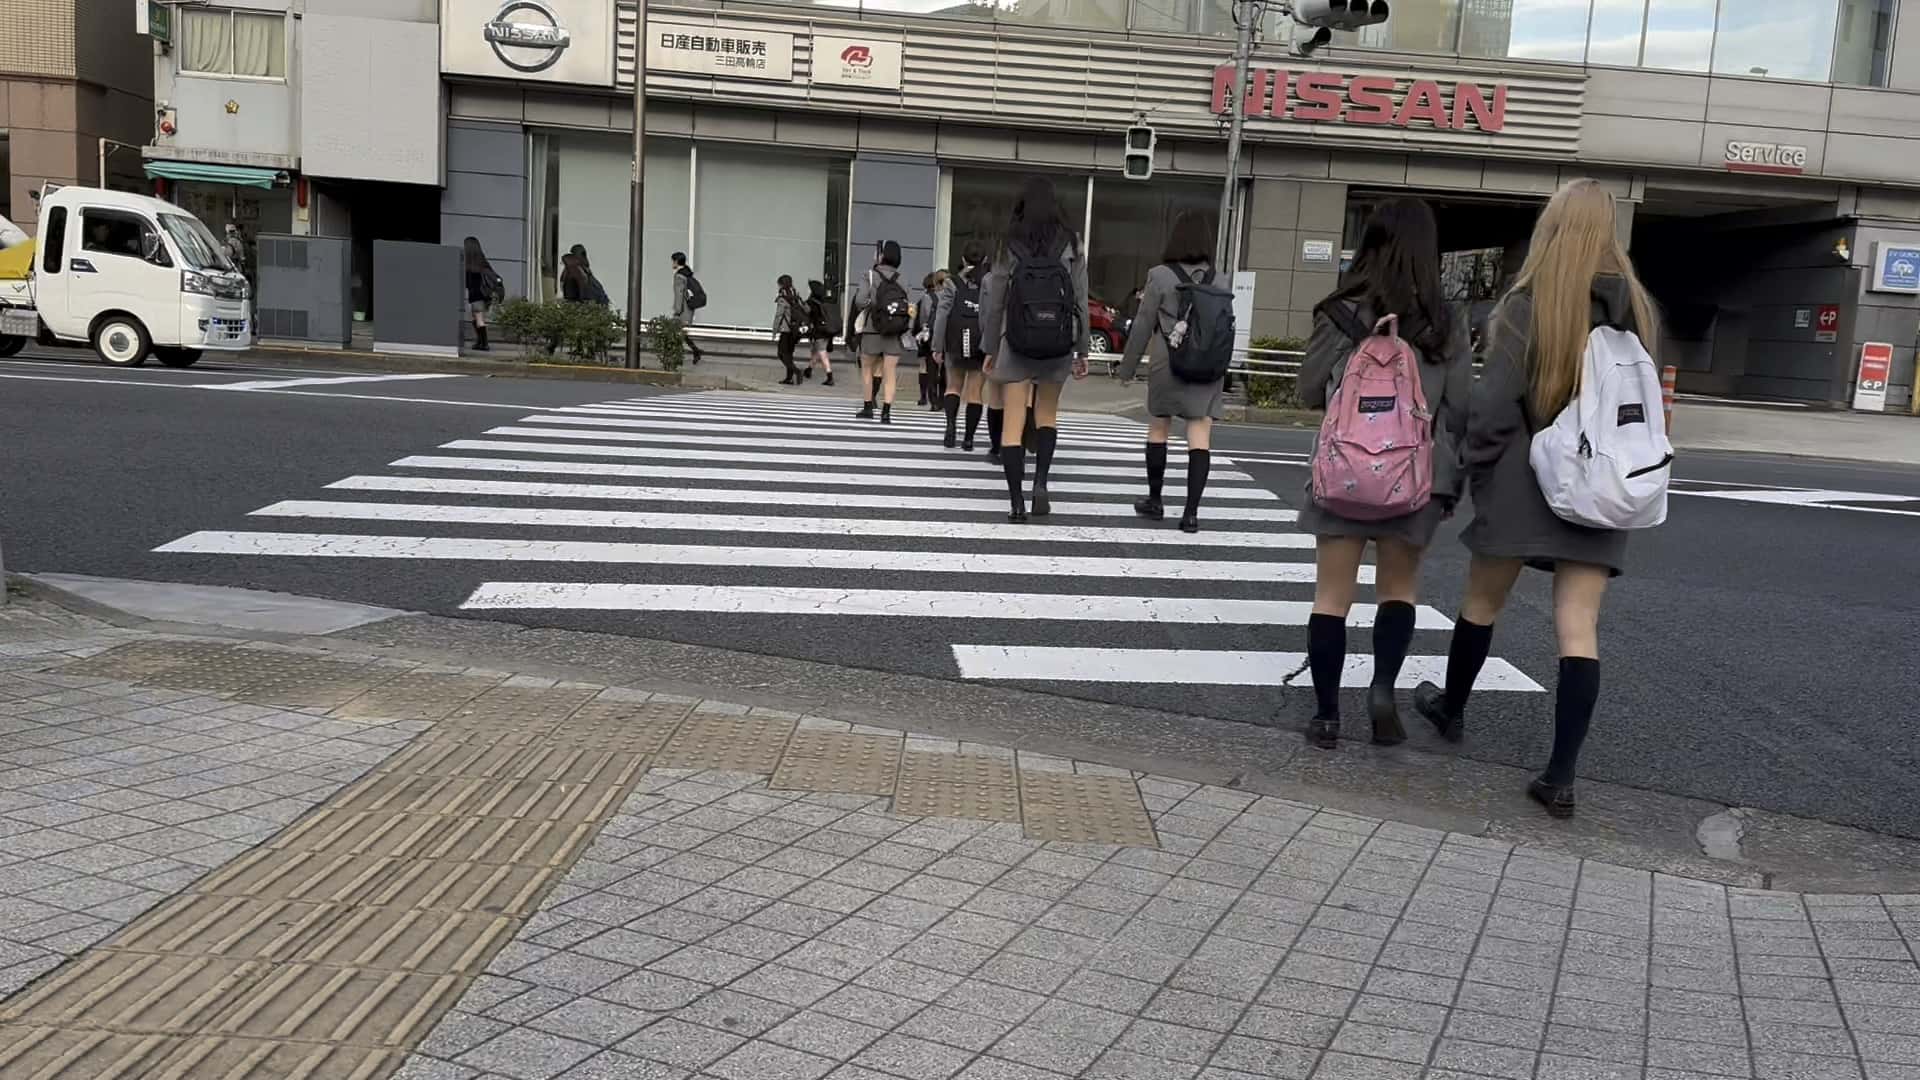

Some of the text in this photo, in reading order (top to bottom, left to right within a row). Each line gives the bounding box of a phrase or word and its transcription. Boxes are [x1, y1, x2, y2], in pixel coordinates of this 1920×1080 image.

[491, 26, 560, 41] NISSAN
[660, 33, 766, 56] 日産自動車販売
[1210, 64, 1508, 133] NISSAN
[1726, 141, 1806, 166] Service
[1828, 311, 1837, 325] P
[1873, 381, 1882, 389] P
